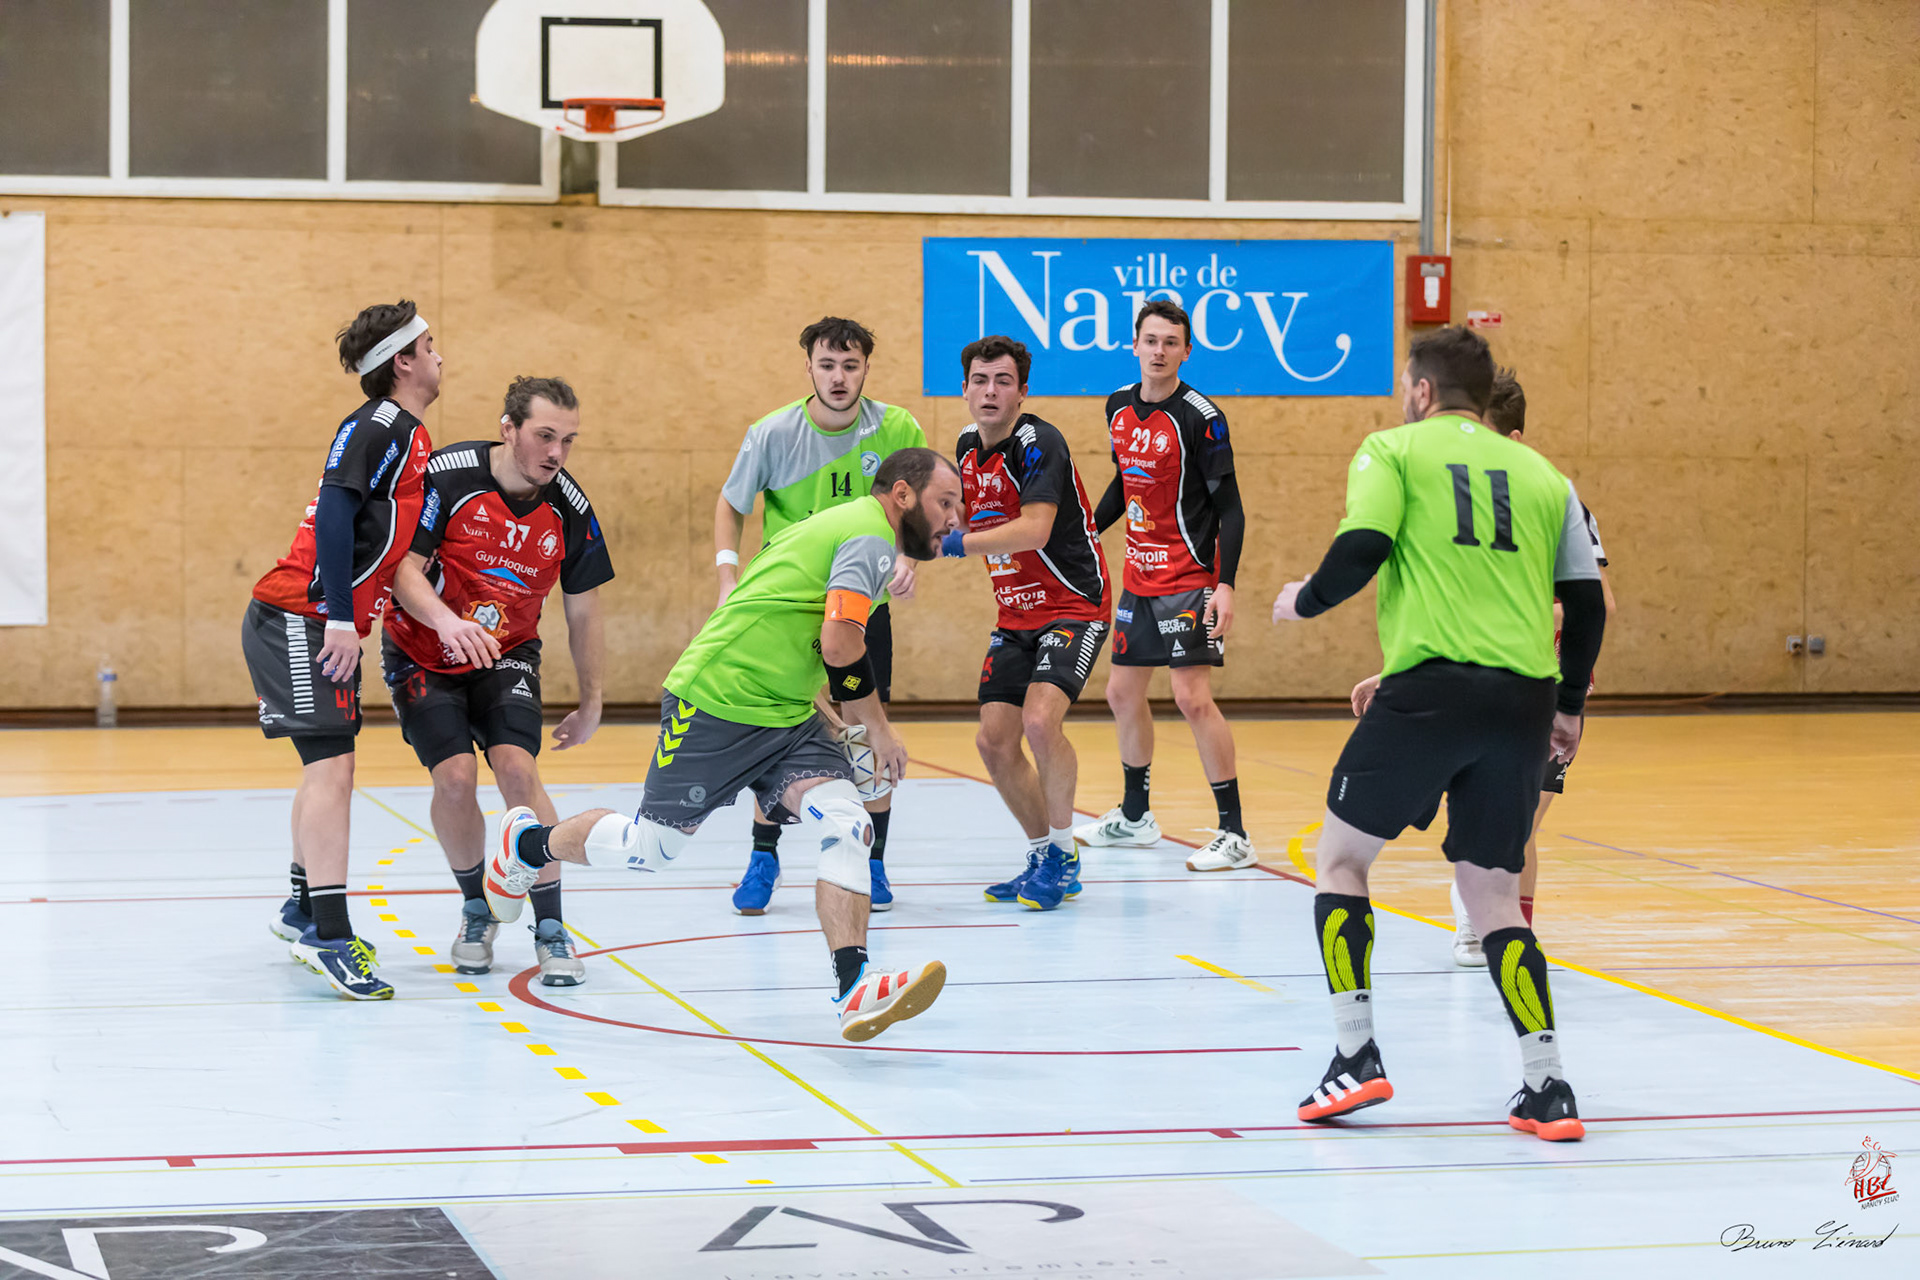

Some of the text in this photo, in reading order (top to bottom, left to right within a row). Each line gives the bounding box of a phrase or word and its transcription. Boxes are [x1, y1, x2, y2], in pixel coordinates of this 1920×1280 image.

[1113, 253, 1238, 287] ville de
[1128, 427, 1151, 453] 29
[1131, 456, 1156, 468] Hoquet
[831, 471, 851, 498] 14
[1446, 463, 1519, 552] 11
[499, 519, 531, 552] 37
[475, 550, 539, 578] Guy Hoquet
[999, 586, 1012, 595] LE
[511, 687, 533, 698] SELECT
